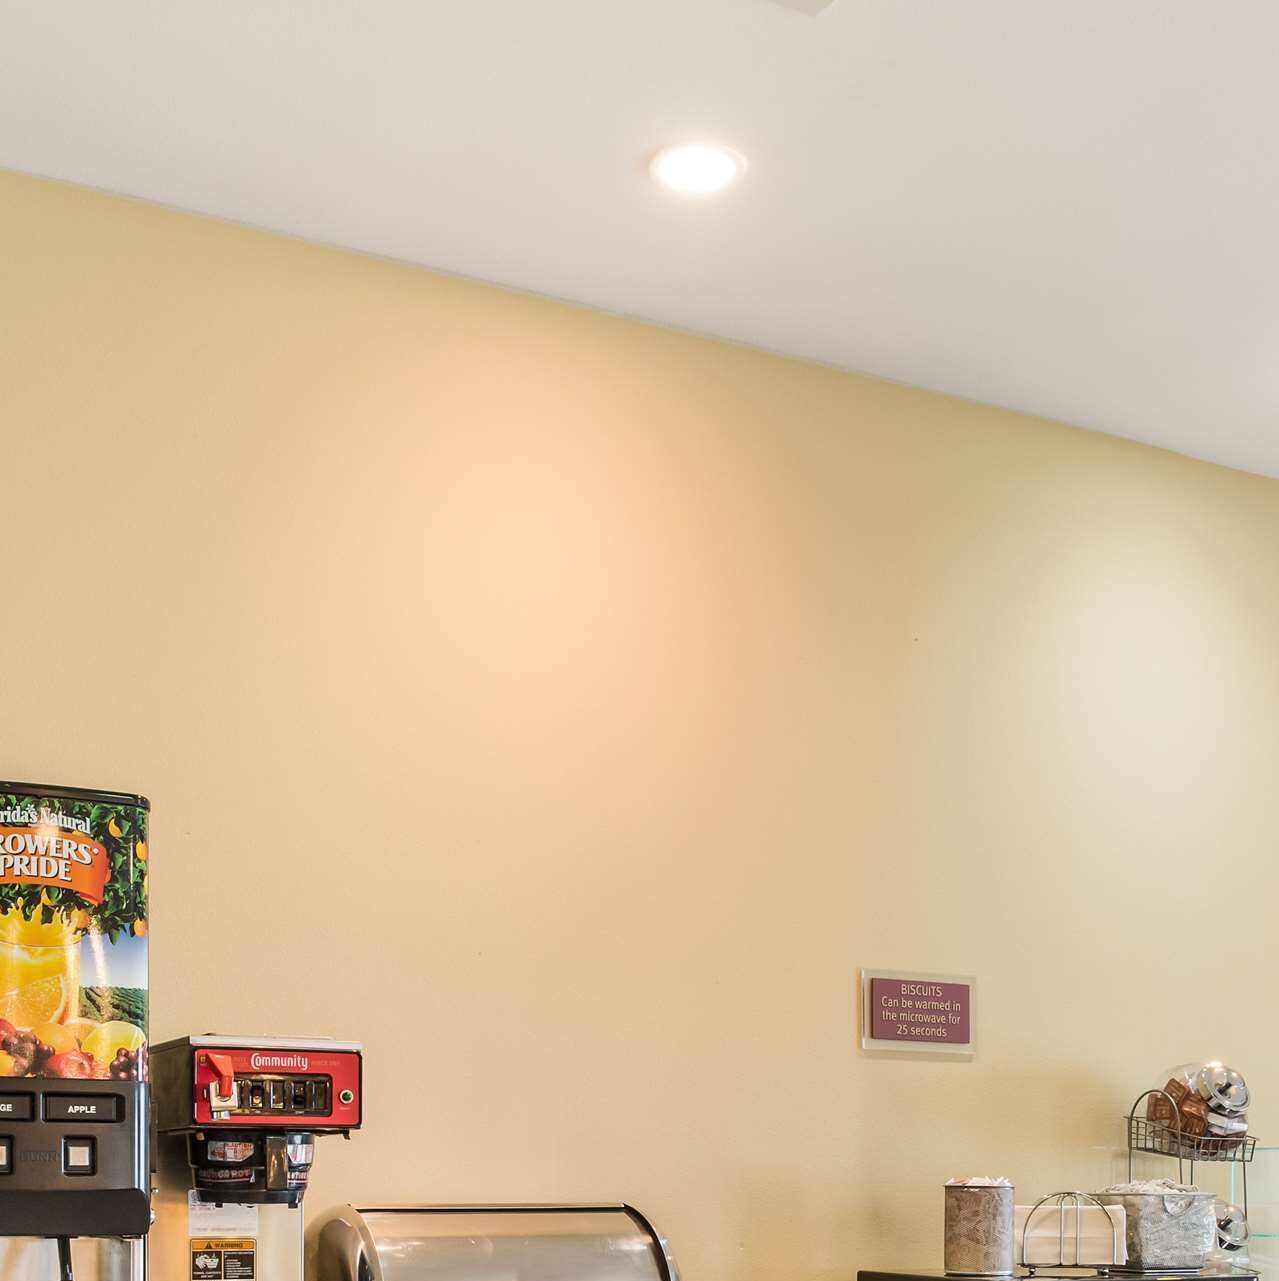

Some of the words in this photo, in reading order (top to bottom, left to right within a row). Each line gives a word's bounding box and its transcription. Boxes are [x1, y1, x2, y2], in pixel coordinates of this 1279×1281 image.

[41, 807, 91, 834] Natural
[901, 984, 943, 997] BISCUITS
[881, 996, 899, 1007] Can
[901, 998, 913, 1009] be
[914, 1000, 951, 1011] warmed
[953, 1001, 961, 1011] in
[882, 1010, 897, 1021] the
[899, 1011, 946, 1024] microwave
[948, 1013, 961, 1025] for
[896, 1024, 908, 1035] 25
[910, 1026, 948, 1038] seconds
[250, 1052, 308, 1070] Community
[67, 1105, 97, 1114] APPLE
